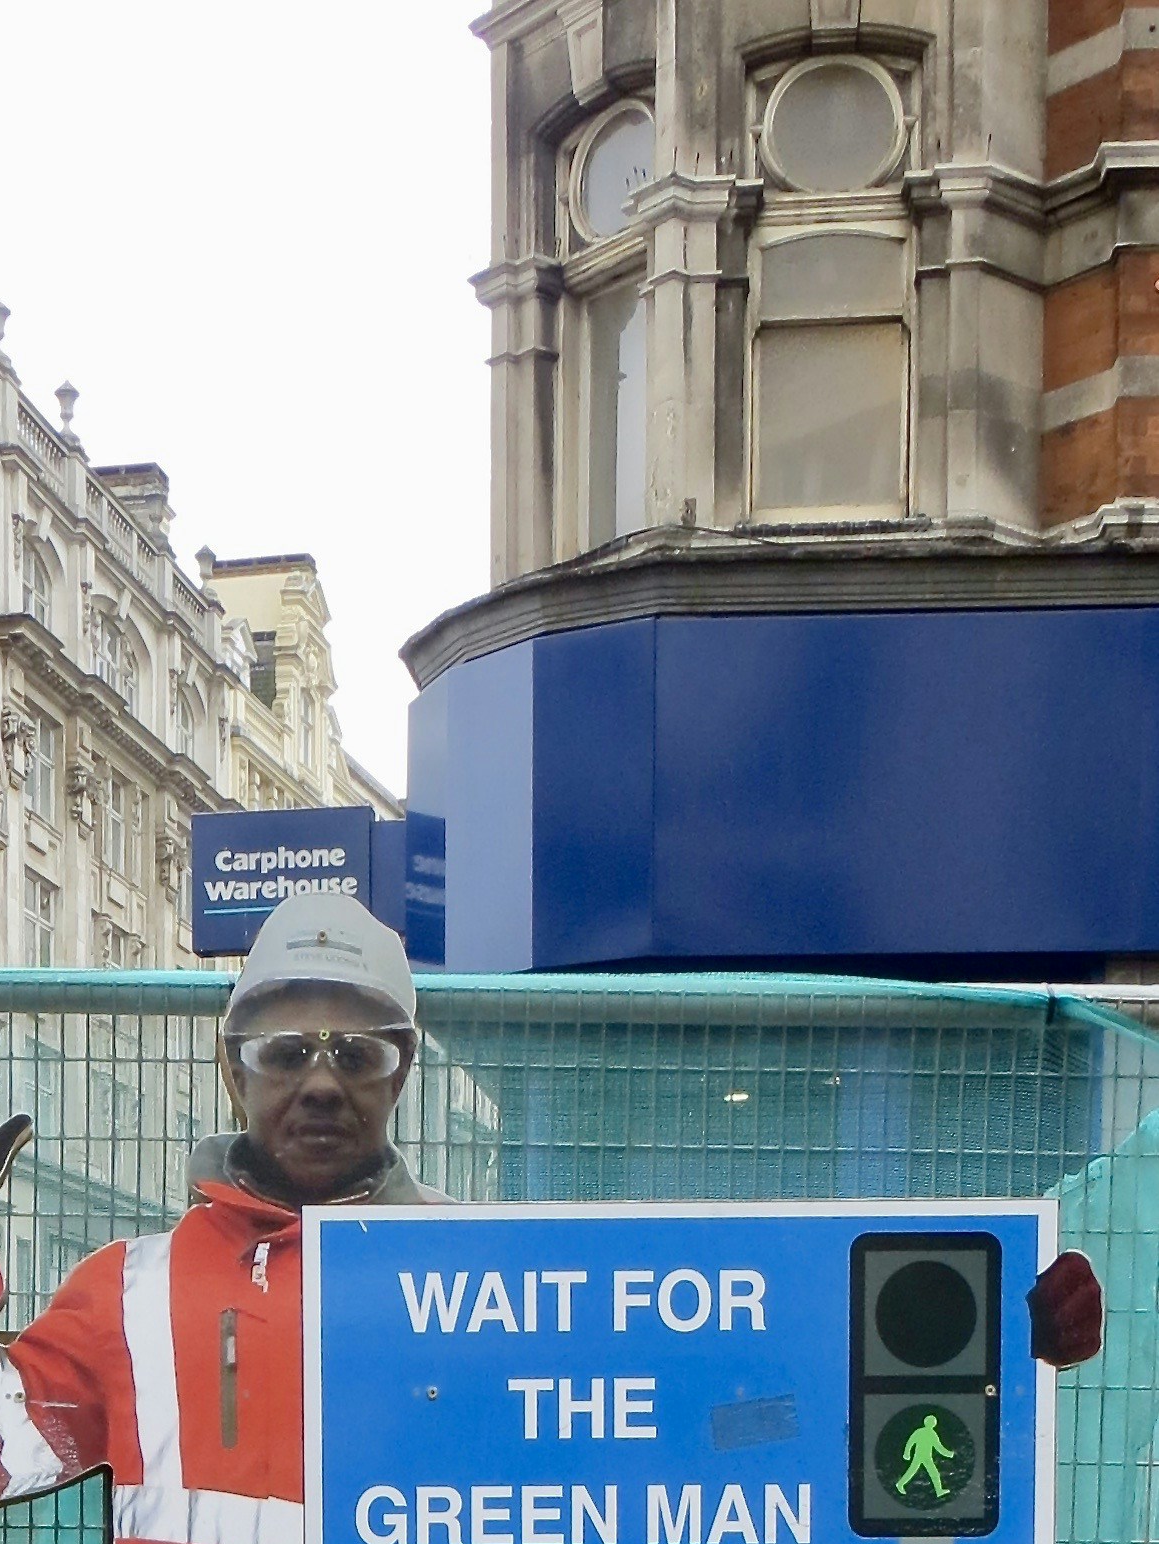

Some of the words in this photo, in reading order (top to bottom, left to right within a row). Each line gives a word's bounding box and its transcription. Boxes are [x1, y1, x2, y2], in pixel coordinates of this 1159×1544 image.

[215, 846, 346, 874] Carphone
[204, 876, 358, 902] Warehouse
[399, 1270, 586, 1333] WAIT
[615, 1268, 767, 1332] FOR
[508, 1377, 657, 1439] THE
